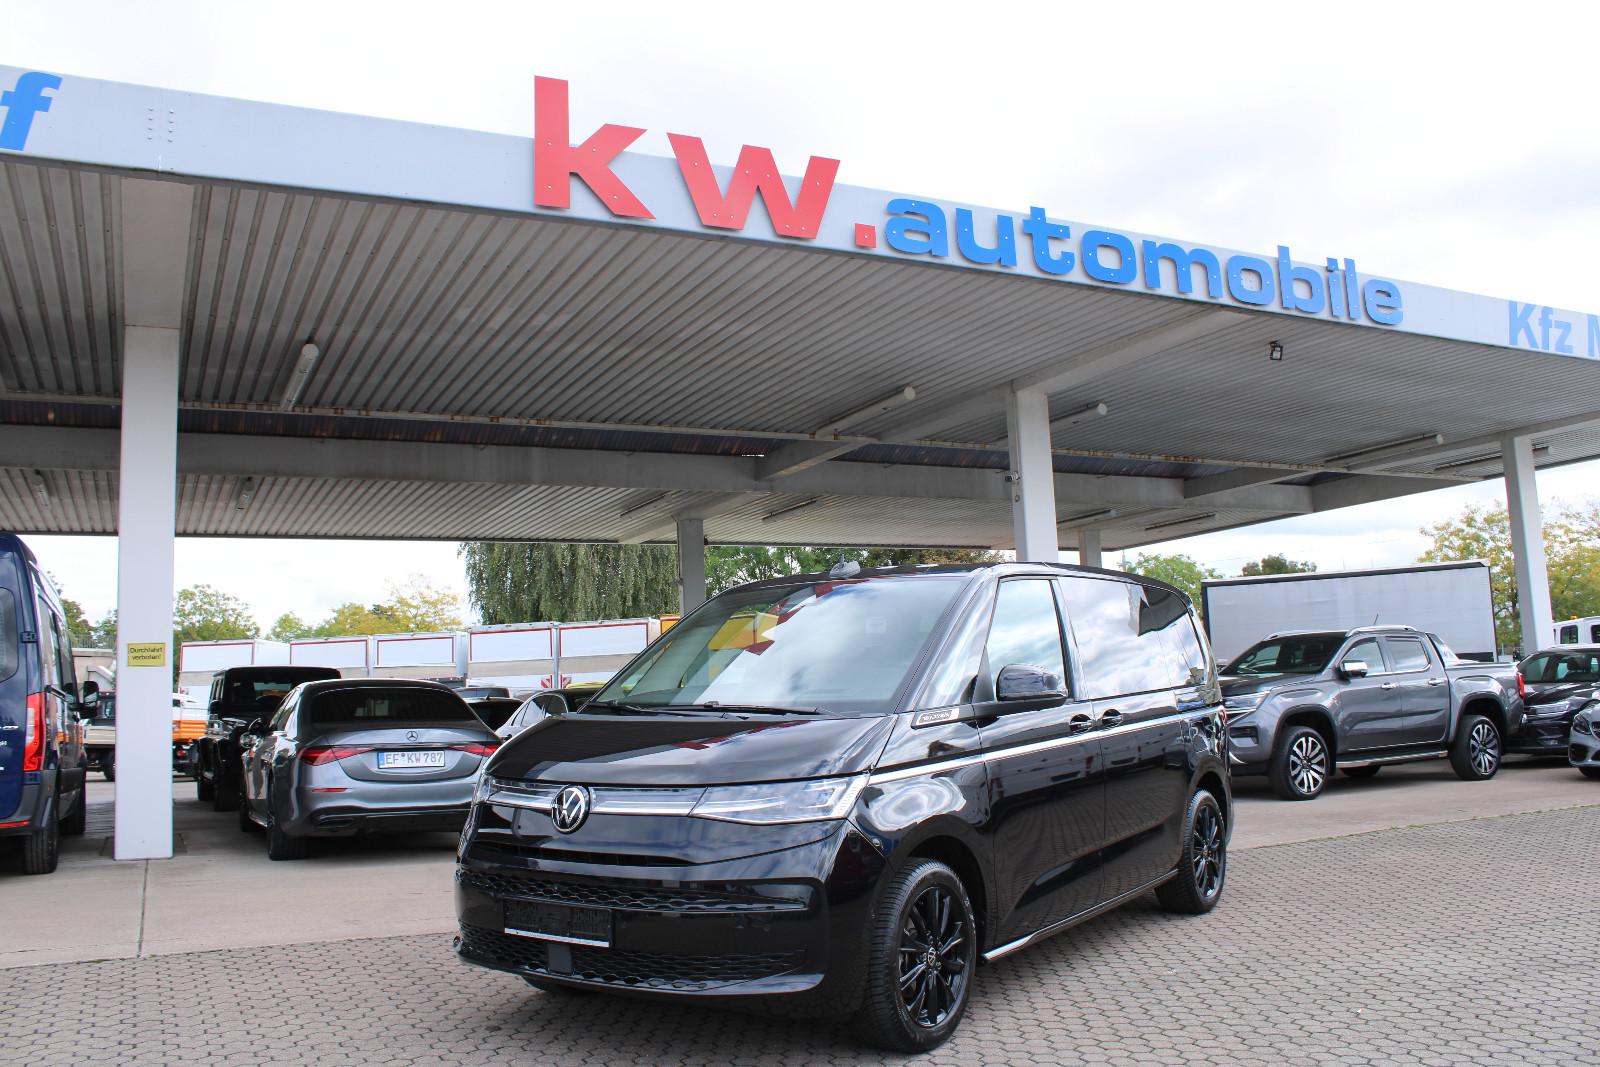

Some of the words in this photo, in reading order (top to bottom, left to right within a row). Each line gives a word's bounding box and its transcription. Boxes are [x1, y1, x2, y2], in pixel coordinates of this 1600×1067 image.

[1508, 300, 1574, 354] Kfz
[385, 753, 400, 765] EF
[407, 753, 421, 764] KW
[423, 752, 443, 763] 787
